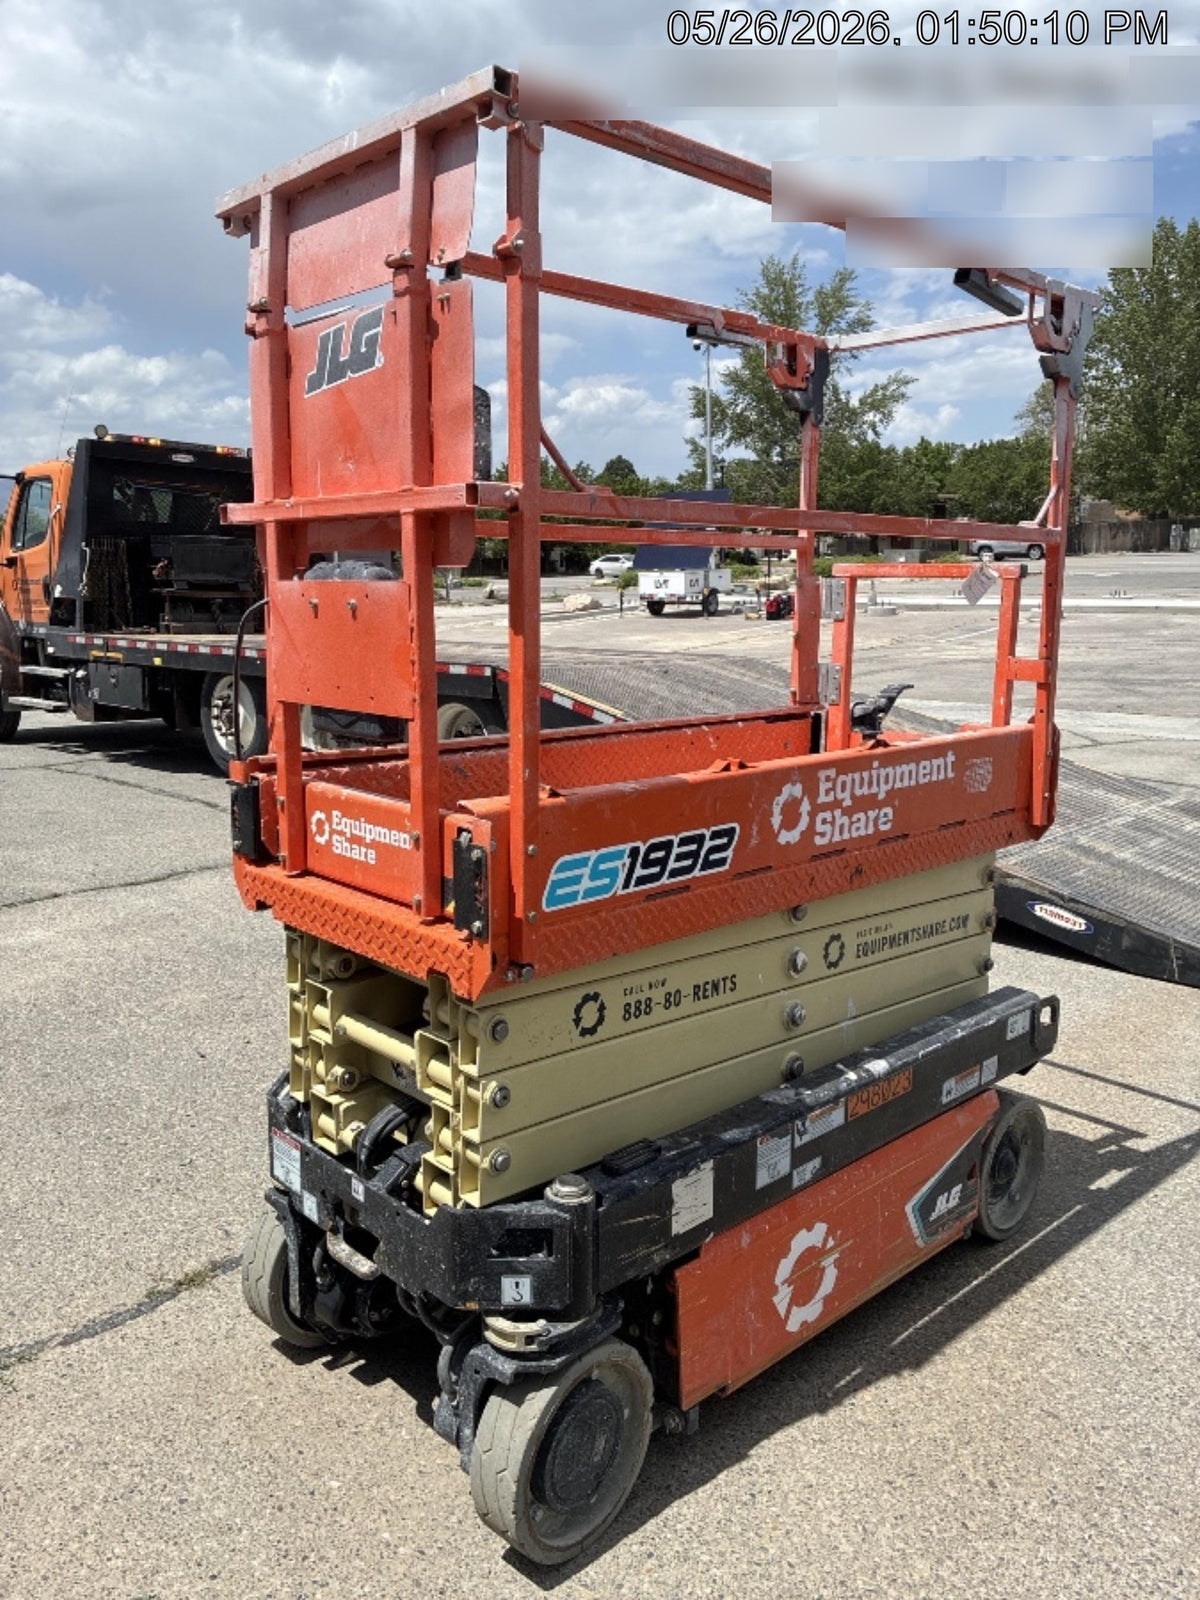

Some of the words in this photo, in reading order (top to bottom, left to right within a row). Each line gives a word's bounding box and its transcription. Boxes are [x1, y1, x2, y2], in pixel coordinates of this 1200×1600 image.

[304, 303, 384, 398] JLG
[817, 750, 956, 807] Equipment
[332, 810, 412, 850] Equipmen
[332, 834, 376, 865] Share
[814, 806, 894, 846] Share
[542, 823, 740, 912] ES1932
[622, 974, 737, 1022] 888-80-RENTS
[849, 1068, 912, 1119] 298023
[929, 1183, 963, 1222] JLG
